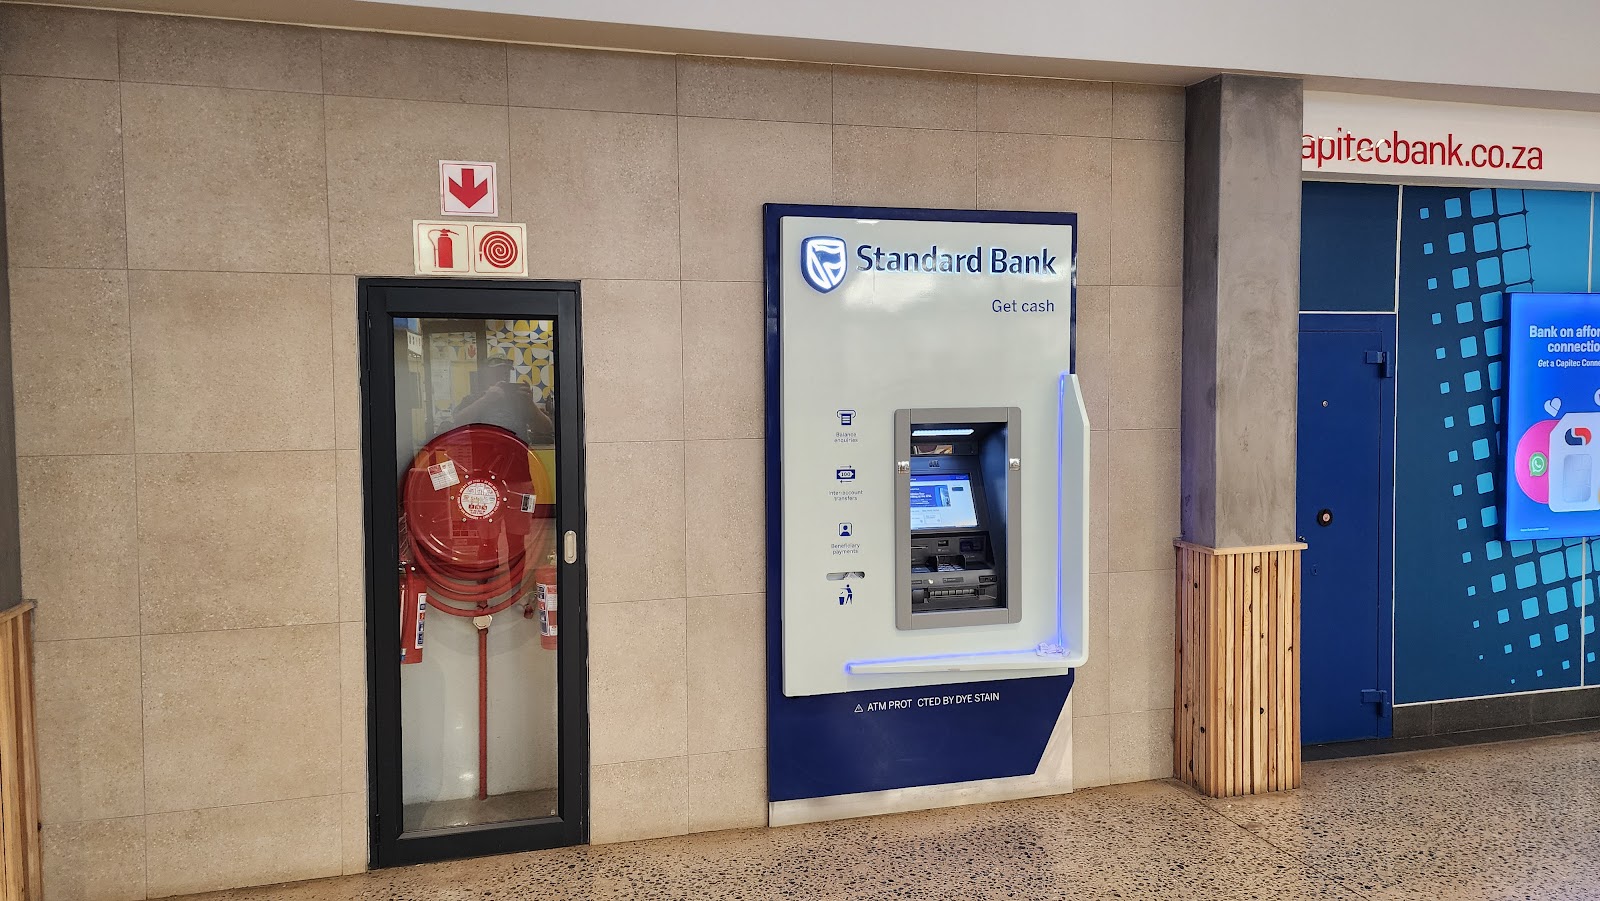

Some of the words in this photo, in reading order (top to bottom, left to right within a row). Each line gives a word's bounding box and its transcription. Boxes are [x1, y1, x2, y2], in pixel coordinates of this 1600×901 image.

[856, 244, 982, 273] Standard
[990, 247, 1057, 275] Bank
[991, 300, 1017, 313] Get
[1021, 299, 1055, 313] cash
[1529, 325, 1558, 338] Bank
[1560, 328, 1574, 338] on
[1547, 340, 1600, 353] connectio
[1538, 359, 1549, 367] Get
[1555, 359, 1580, 368] Capitec
[867, 701, 887, 712] ATM
[942, 696, 954, 705] BY
[955, 694, 973, 704] DYE
[974, 692, 1000, 703] STAIN
